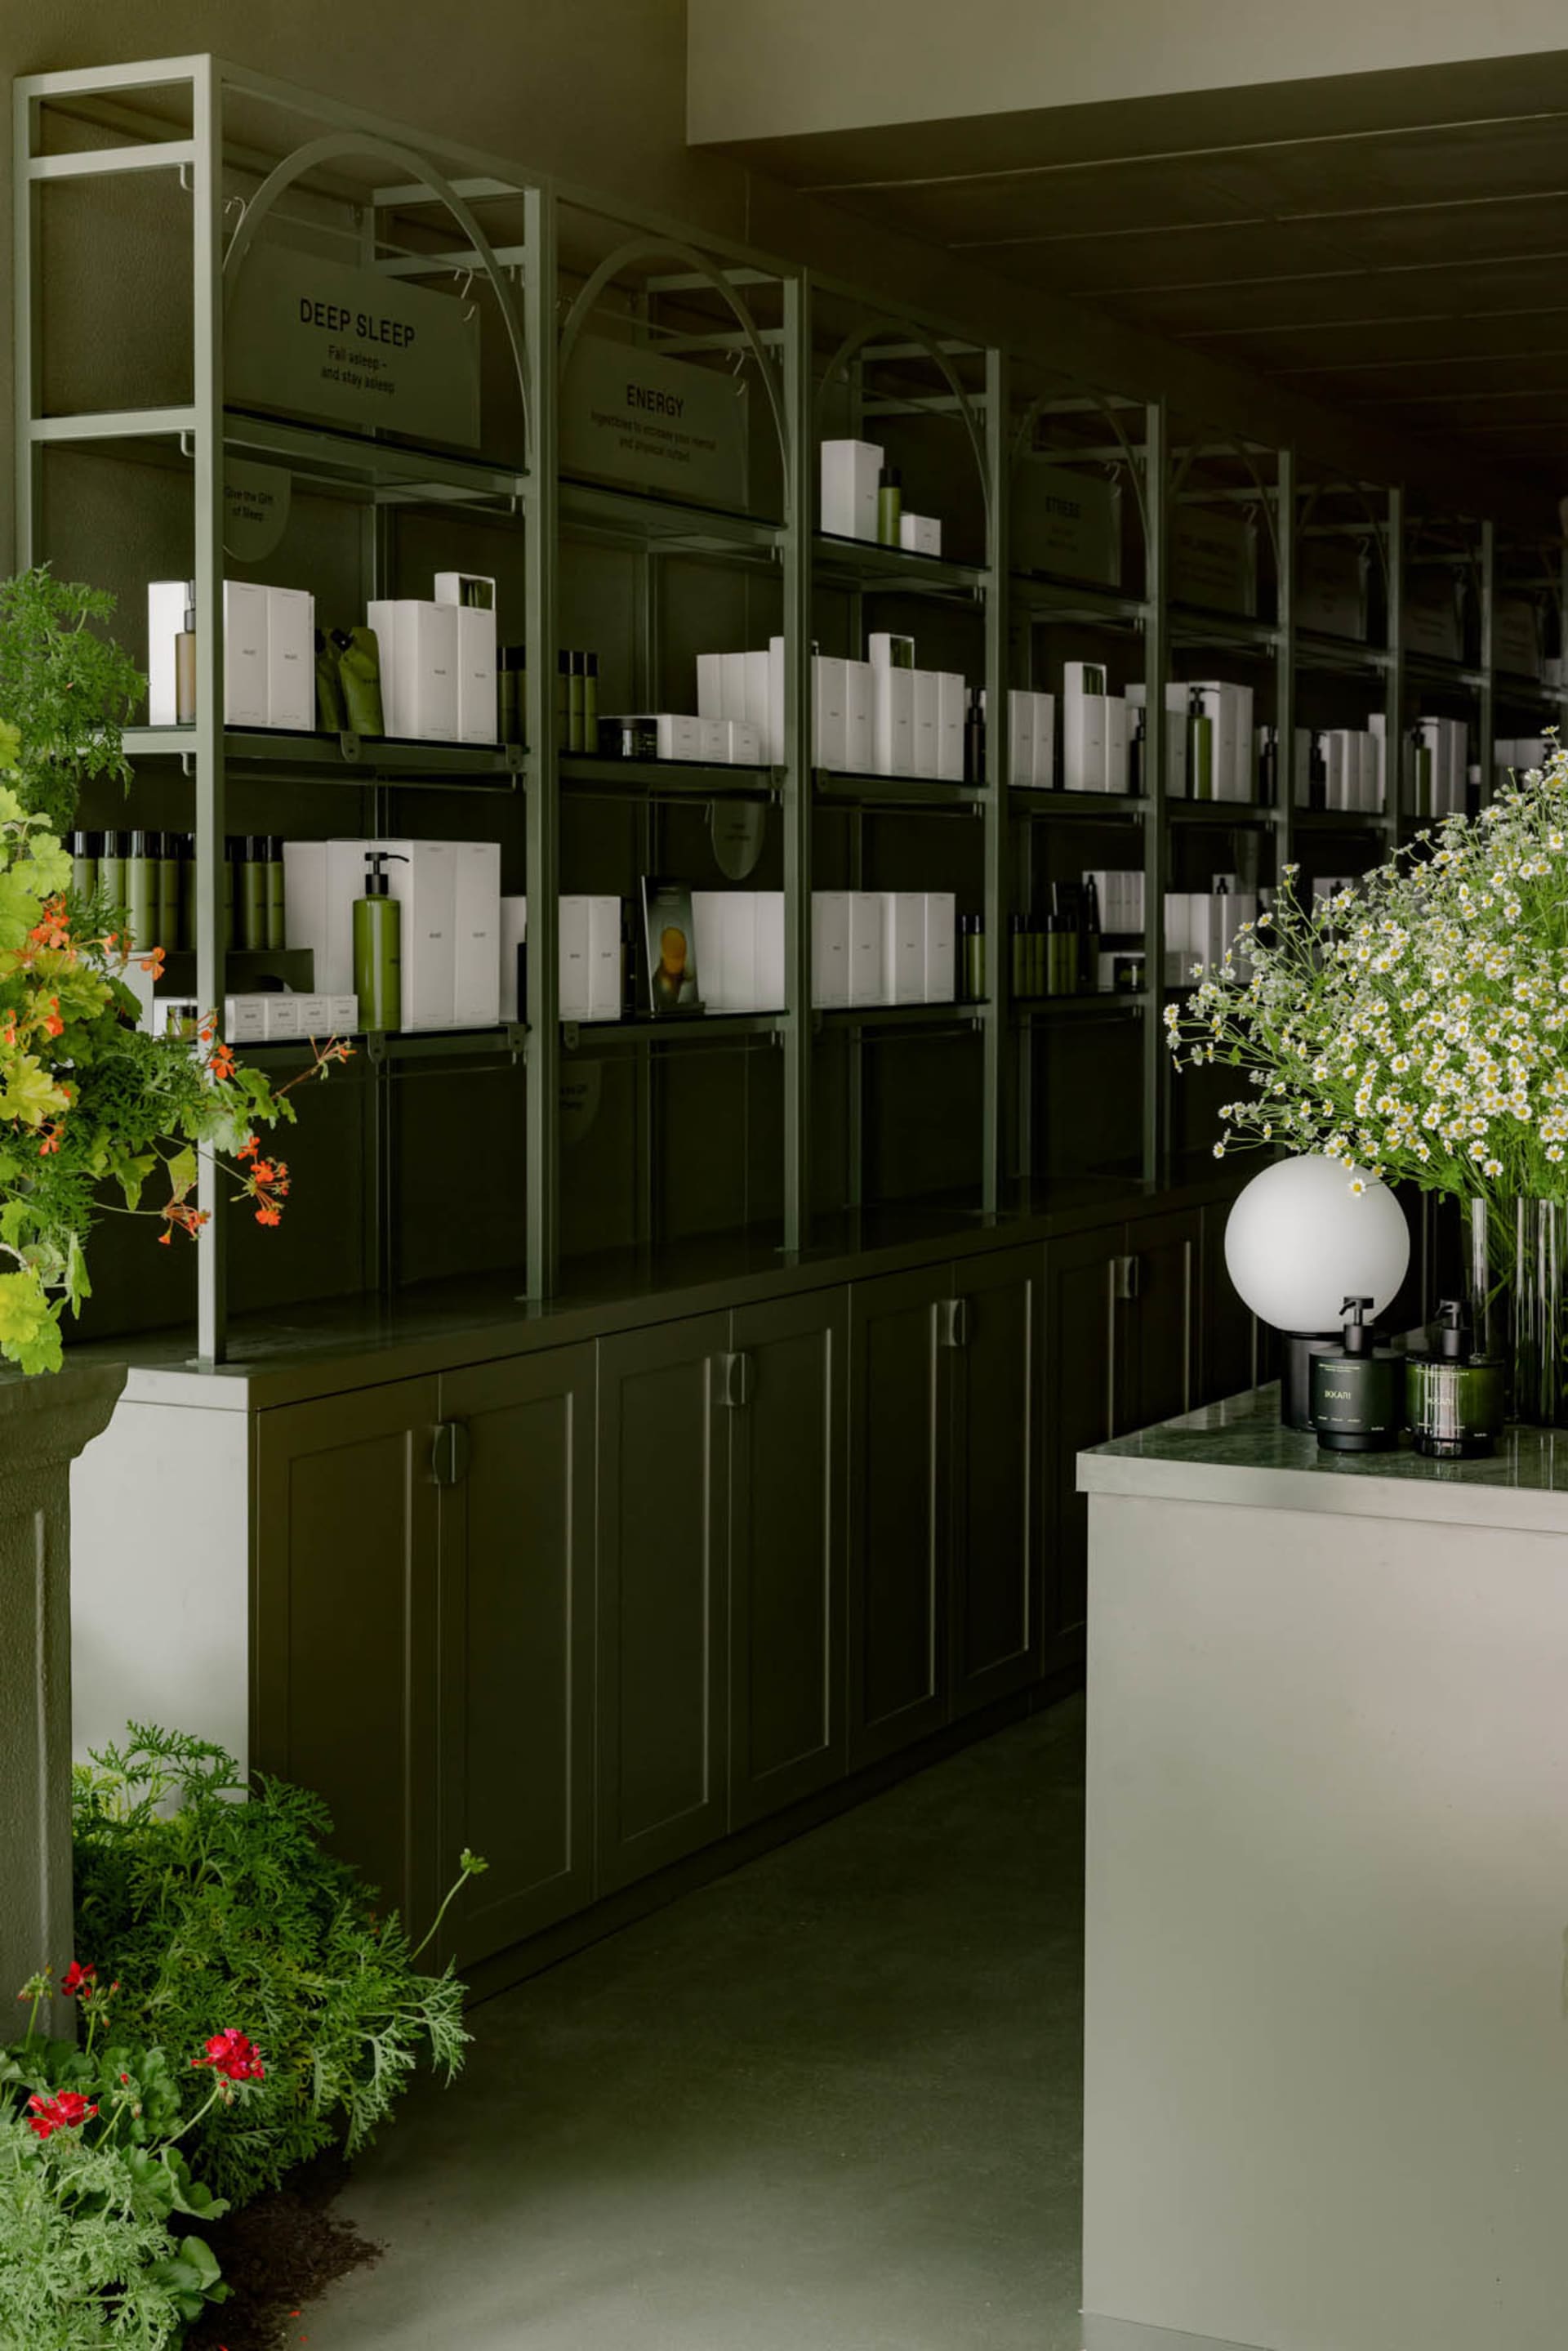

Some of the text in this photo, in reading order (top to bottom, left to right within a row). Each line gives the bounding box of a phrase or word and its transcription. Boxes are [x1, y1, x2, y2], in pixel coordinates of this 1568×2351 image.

[301, 298, 415, 347] DEEP SLEEP
[626, 384, 684, 418] ENERGY
